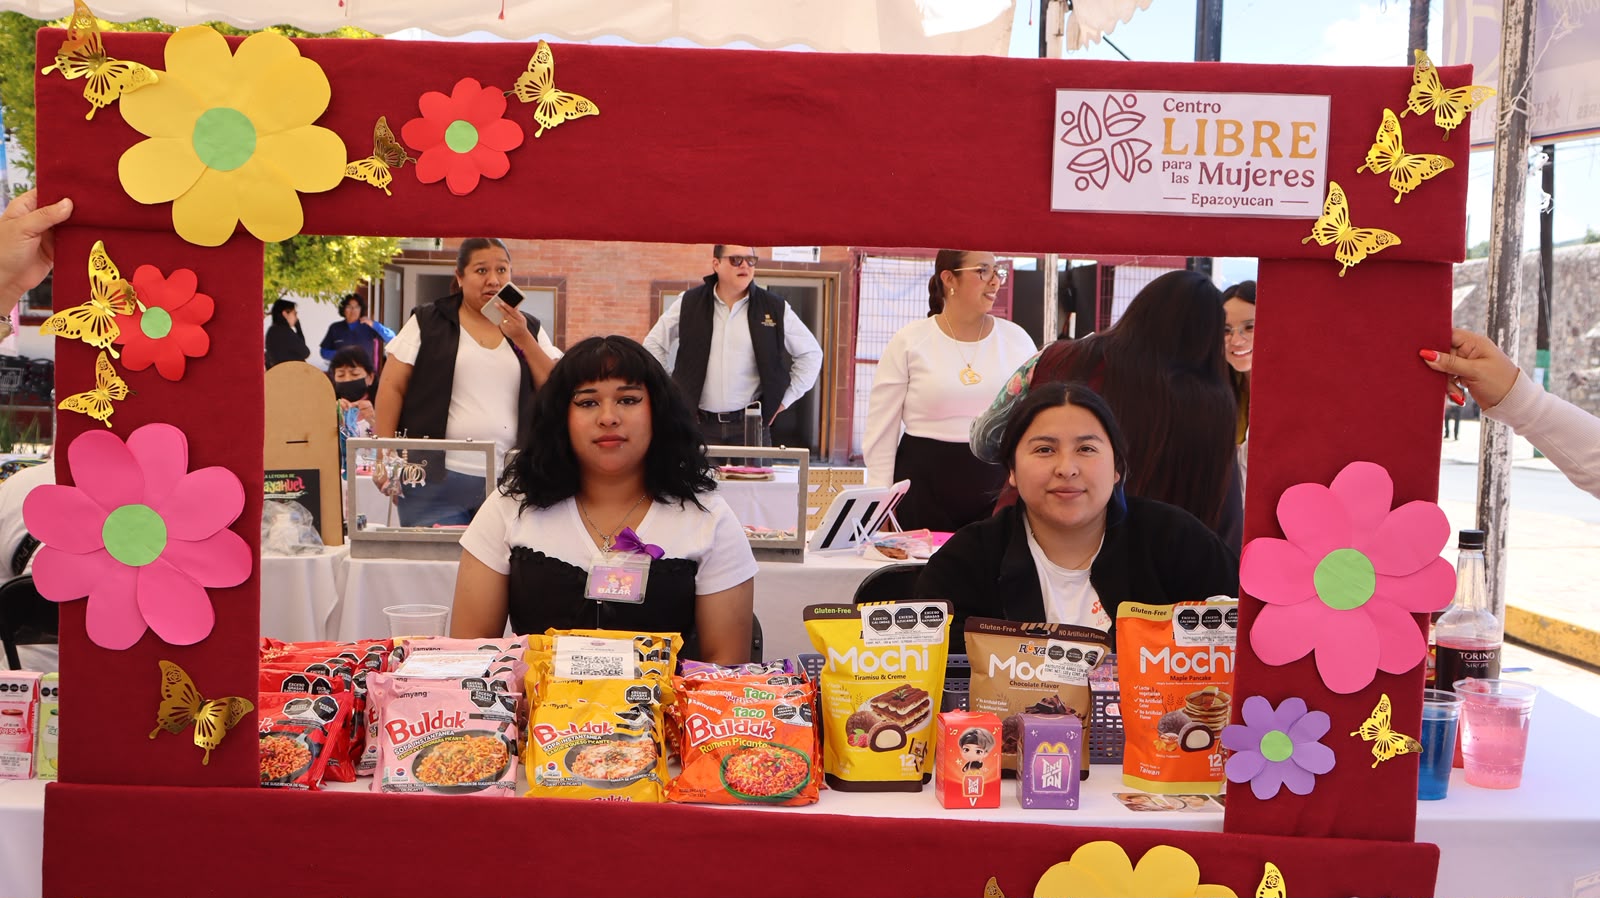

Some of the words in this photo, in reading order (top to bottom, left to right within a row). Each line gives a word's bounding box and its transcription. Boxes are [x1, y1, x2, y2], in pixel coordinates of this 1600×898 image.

[1163, 98, 1222, 114] Centro
[1161, 117, 1317, 159] LIBRE
[1162, 159, 1192, 171] para
[1198, 161, 1315, 192] Mujeres
[1171, 172, 1189, 184] las
[1191, 193, 1274, 208] Epazoyucan
[598, 588, 631, 596] BAZAR
[1130, 606, 1167, 616] Gluten-Free
[980, 623, 1016, 632] Gluten-Free
[1018, 643, 1046, 656] Roya
[1459, 652, 1495, 660] TORINO
[828, 644, 929, 673] Mochi
[1139, 644, 1236, 674] Mochi
[733, 706, 766, 718] Taco
[384, 709, 466, 746] Buldak
[533, 721, 614, 747] Buldak
[686, 713, 776, 747] Buldak
[394, 744, 412, 755] SOPA
[699, 740, 731, 754] Ramen
[732, 737, 768, 748] Picante
[899, 754, 916, 767] 12
[1208, 754, 1222, 767] 12
[1139, 766, 1160, 775] Taiwan
[969, 797, 977, 806] V
